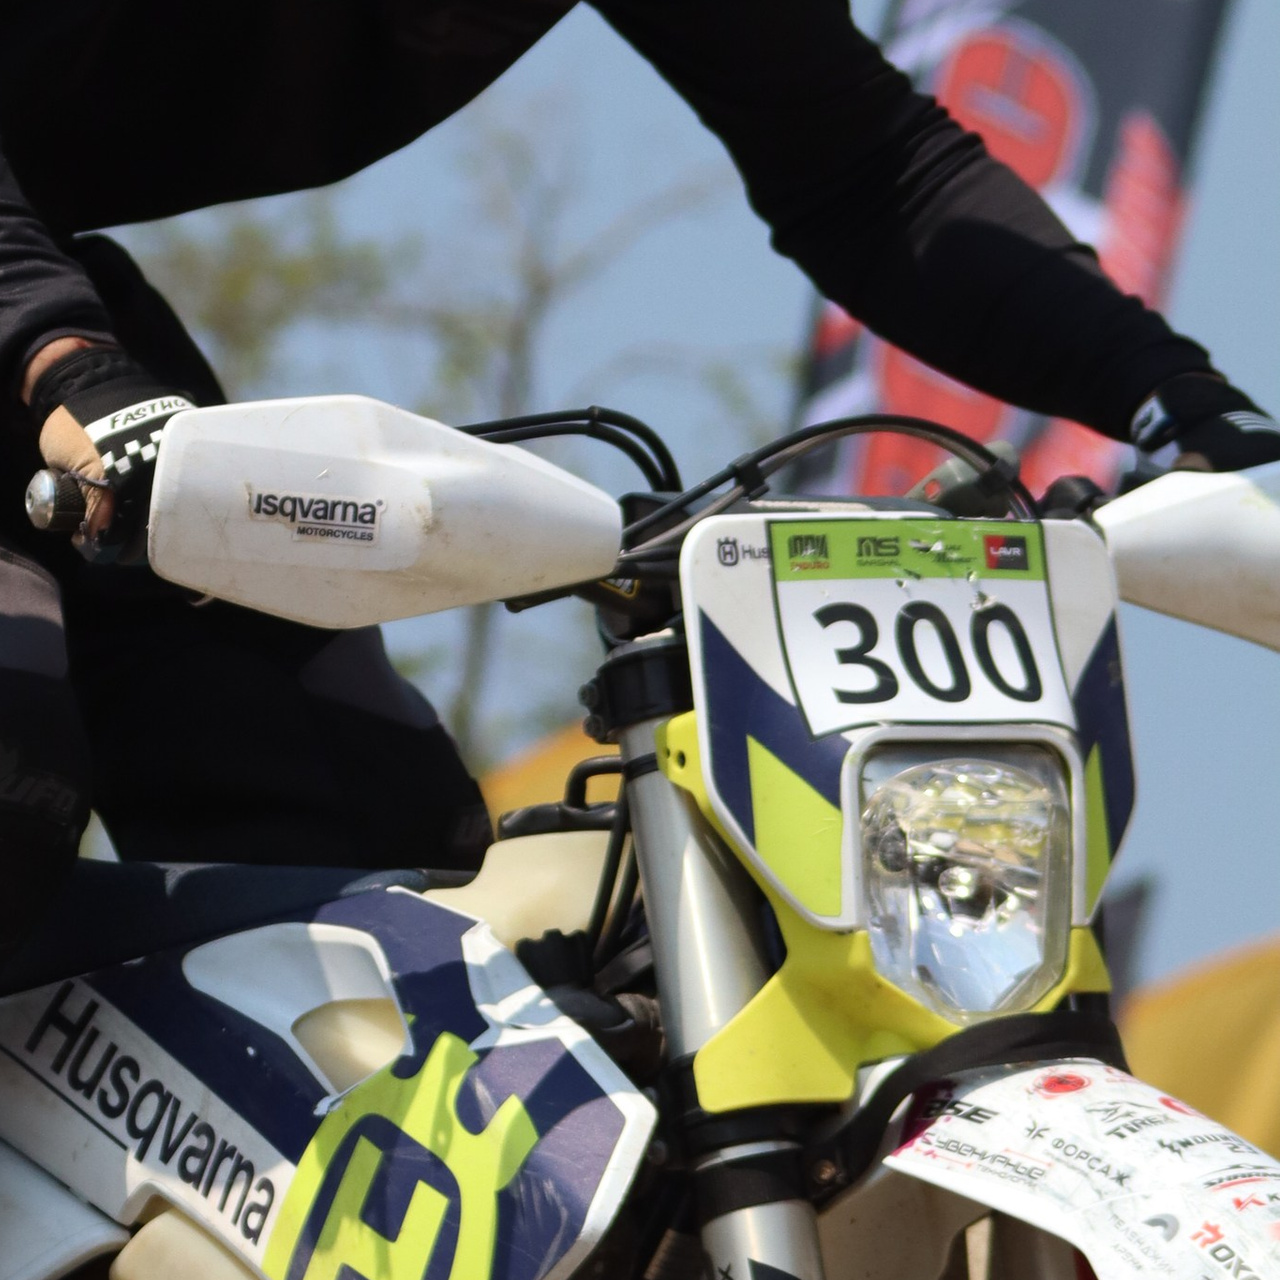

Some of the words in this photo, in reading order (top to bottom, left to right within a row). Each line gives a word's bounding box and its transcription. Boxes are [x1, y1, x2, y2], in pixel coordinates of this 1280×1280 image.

[296, 526, 374, 541] MOTORCYCLES
[812, 601, 1043, 704] 300
[25, 980, 277, 1247] Husqvarna
[1051, 1138, 1131, 1187] ФОРСАЖ
